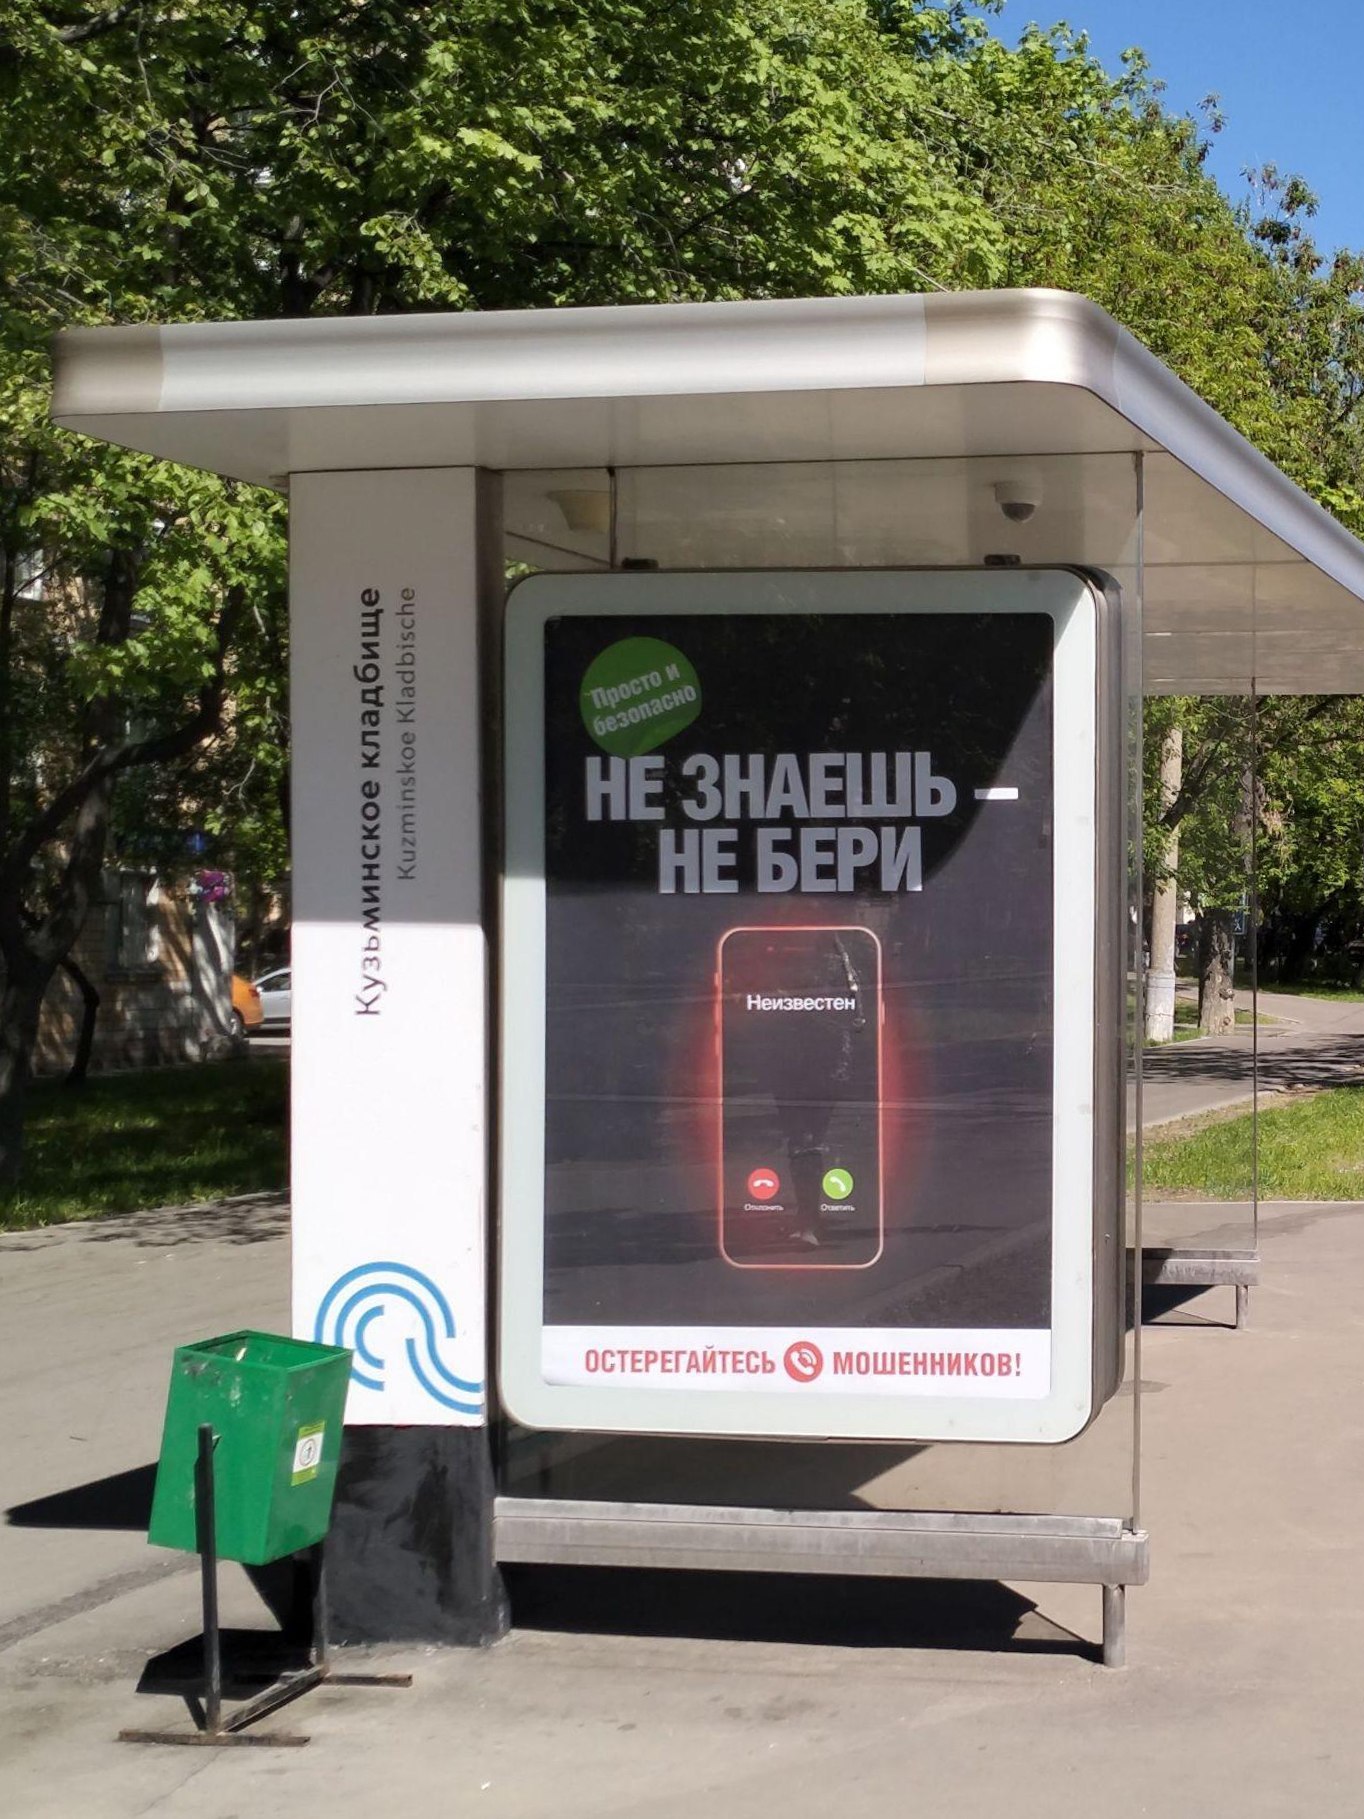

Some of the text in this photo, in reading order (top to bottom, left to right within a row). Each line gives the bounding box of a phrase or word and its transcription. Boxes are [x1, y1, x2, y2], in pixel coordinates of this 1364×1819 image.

[590, 662, 681, 709] Просто и
[592, 684, 698, 736] безопасно
[395, 587, 416, 880] Kuzminskoe Kladbische
[353, 587, 388, 1015] Кузьминское кладбище
[585, 755, 666, 821] НЕ
[681, 752, 958, 821] ЗНАЕШЬ
[657, 825, 923, 894] НЕ БЕРИ
[746, 993, 856, 1011] Неизвестен
[584, 1344, 1021, 1377] ОСТЕРЕГАЙТЕСЬ МОШЕННИКОВ!
